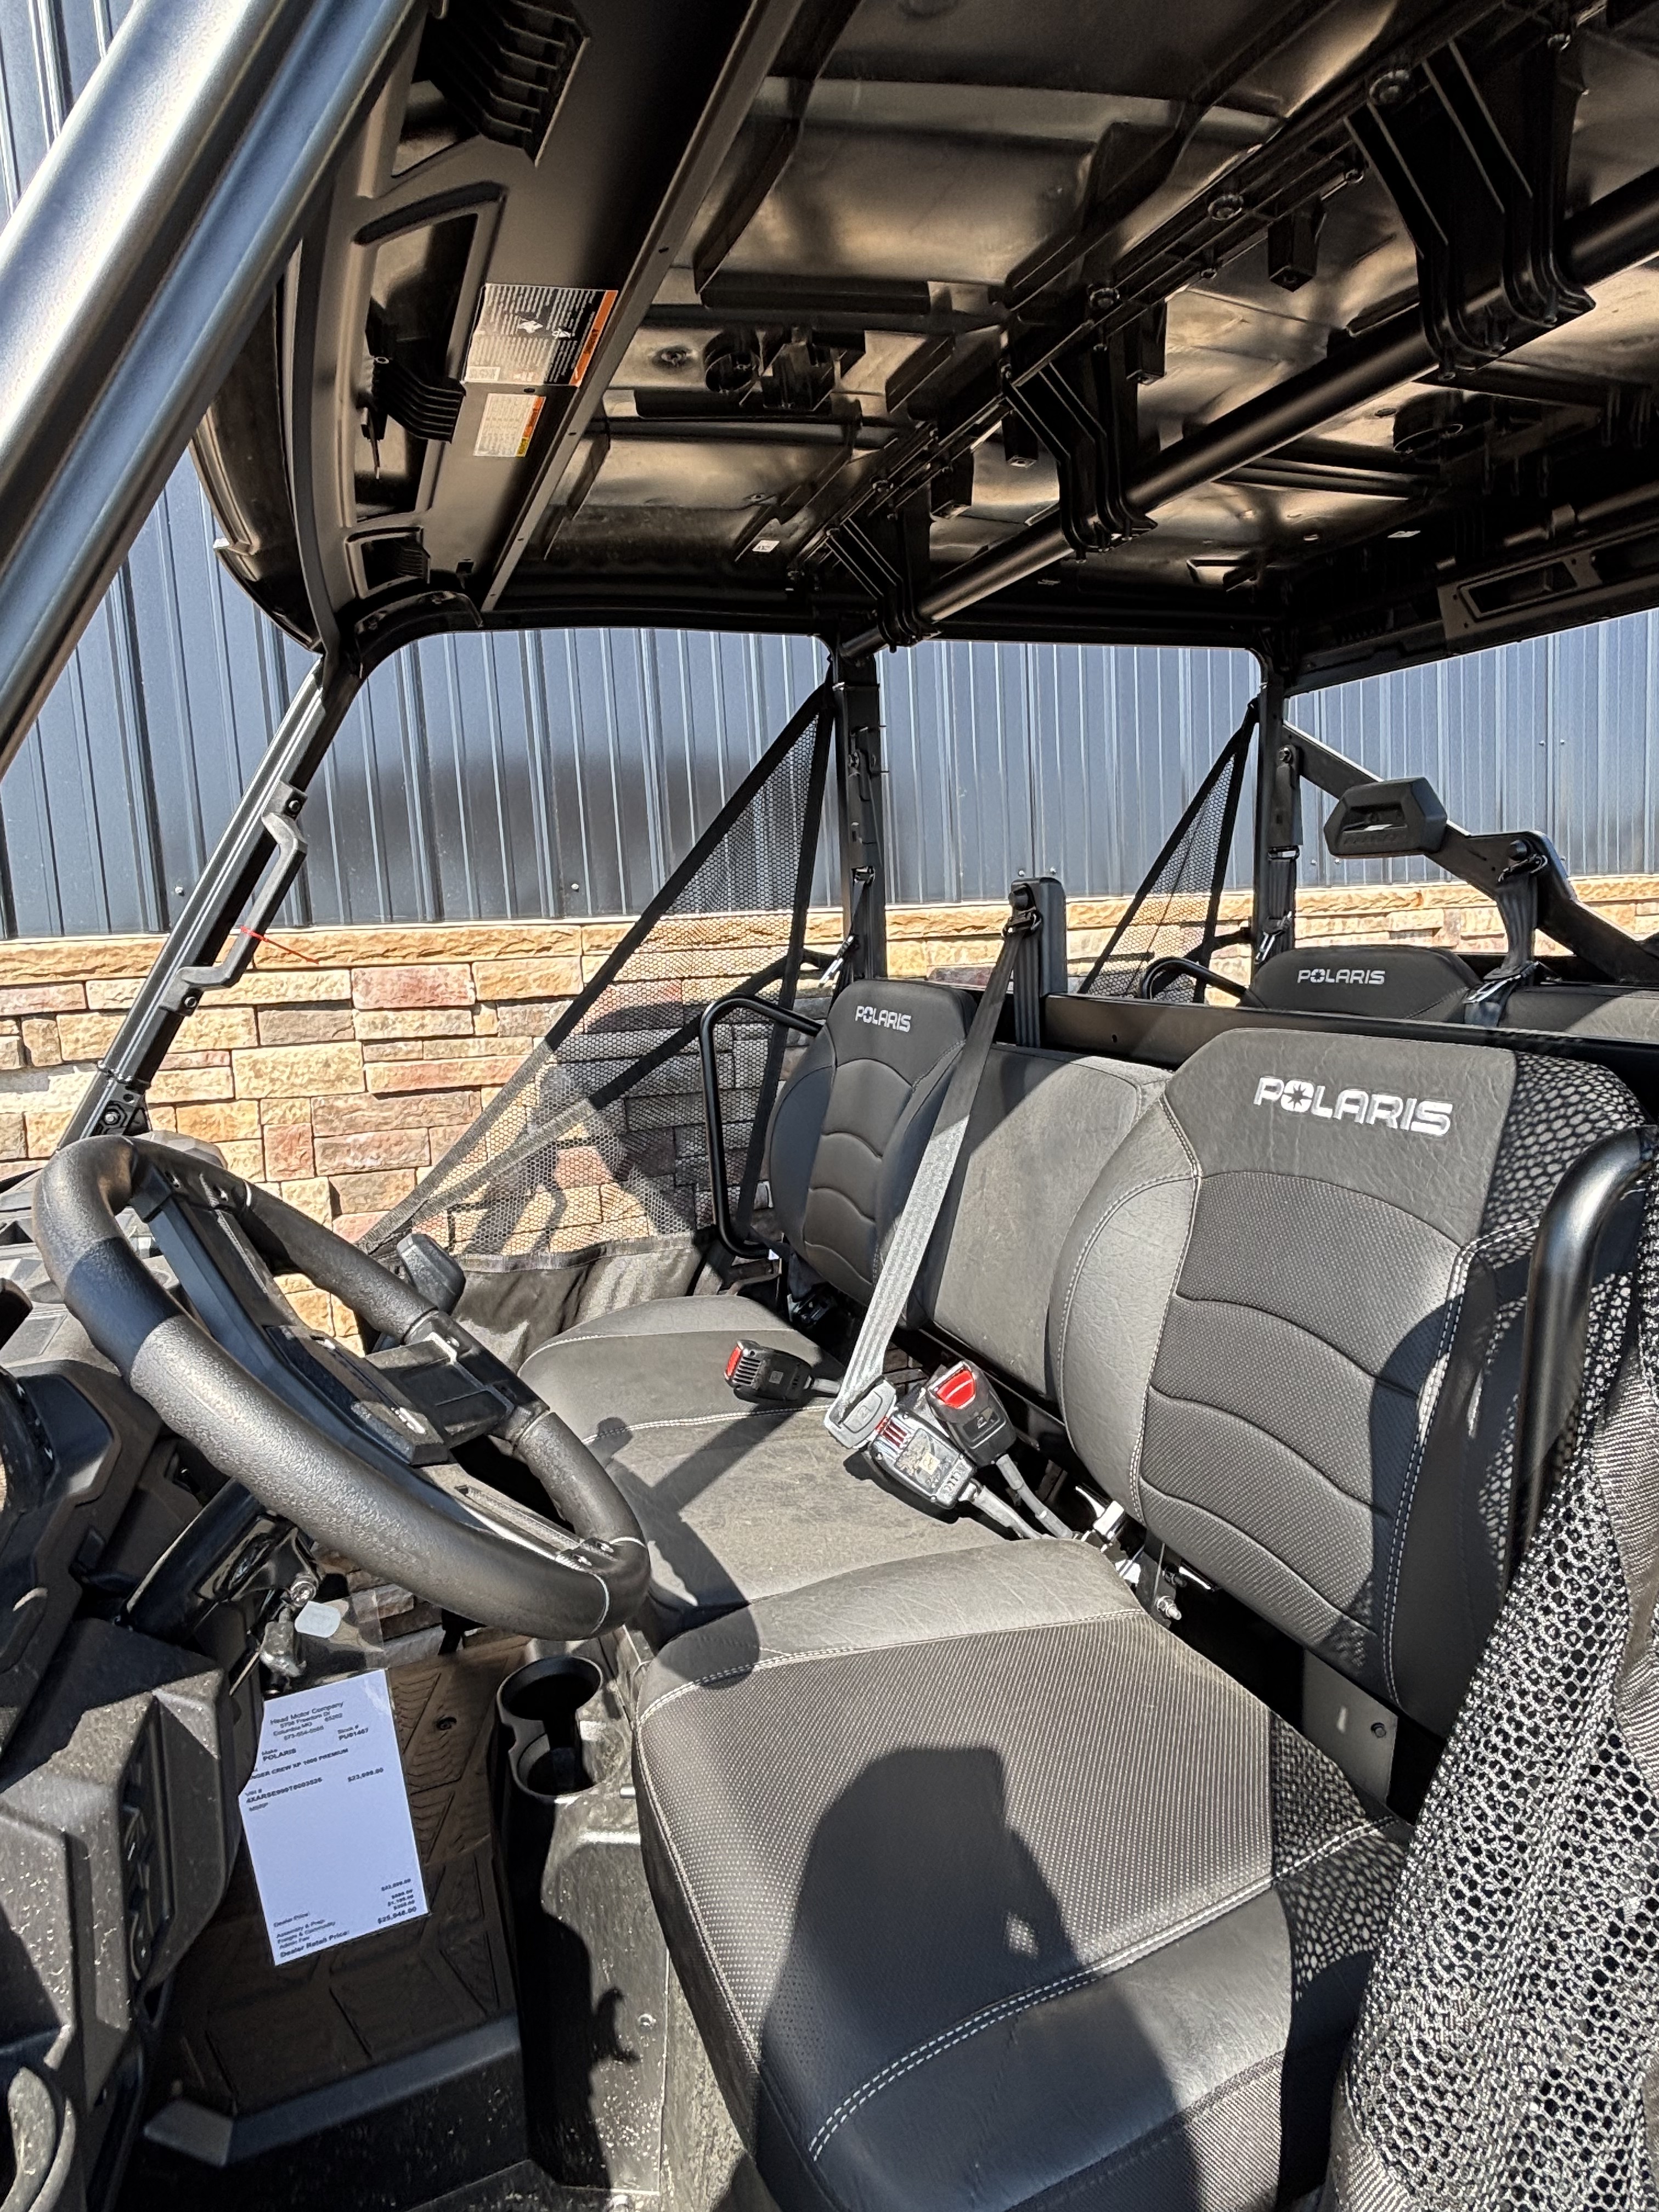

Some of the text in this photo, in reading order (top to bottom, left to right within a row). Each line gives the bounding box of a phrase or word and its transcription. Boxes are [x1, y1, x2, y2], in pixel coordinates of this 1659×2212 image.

[1297, 969, 1386, 985] POLARIS
[855, 1006, 912, 1032] POLARIS
[1253, 1076, 1453, 1136] POLARIS
[270, 1702, 344, 1725] Head Motor Company
[263, 1748, 296, 1762] POLARIS
[272, 1765, 291, 1774] CREW
[318, 1748, 348, 1760] PREMIUM
[280, 1945, 304, 1957] Dealer
